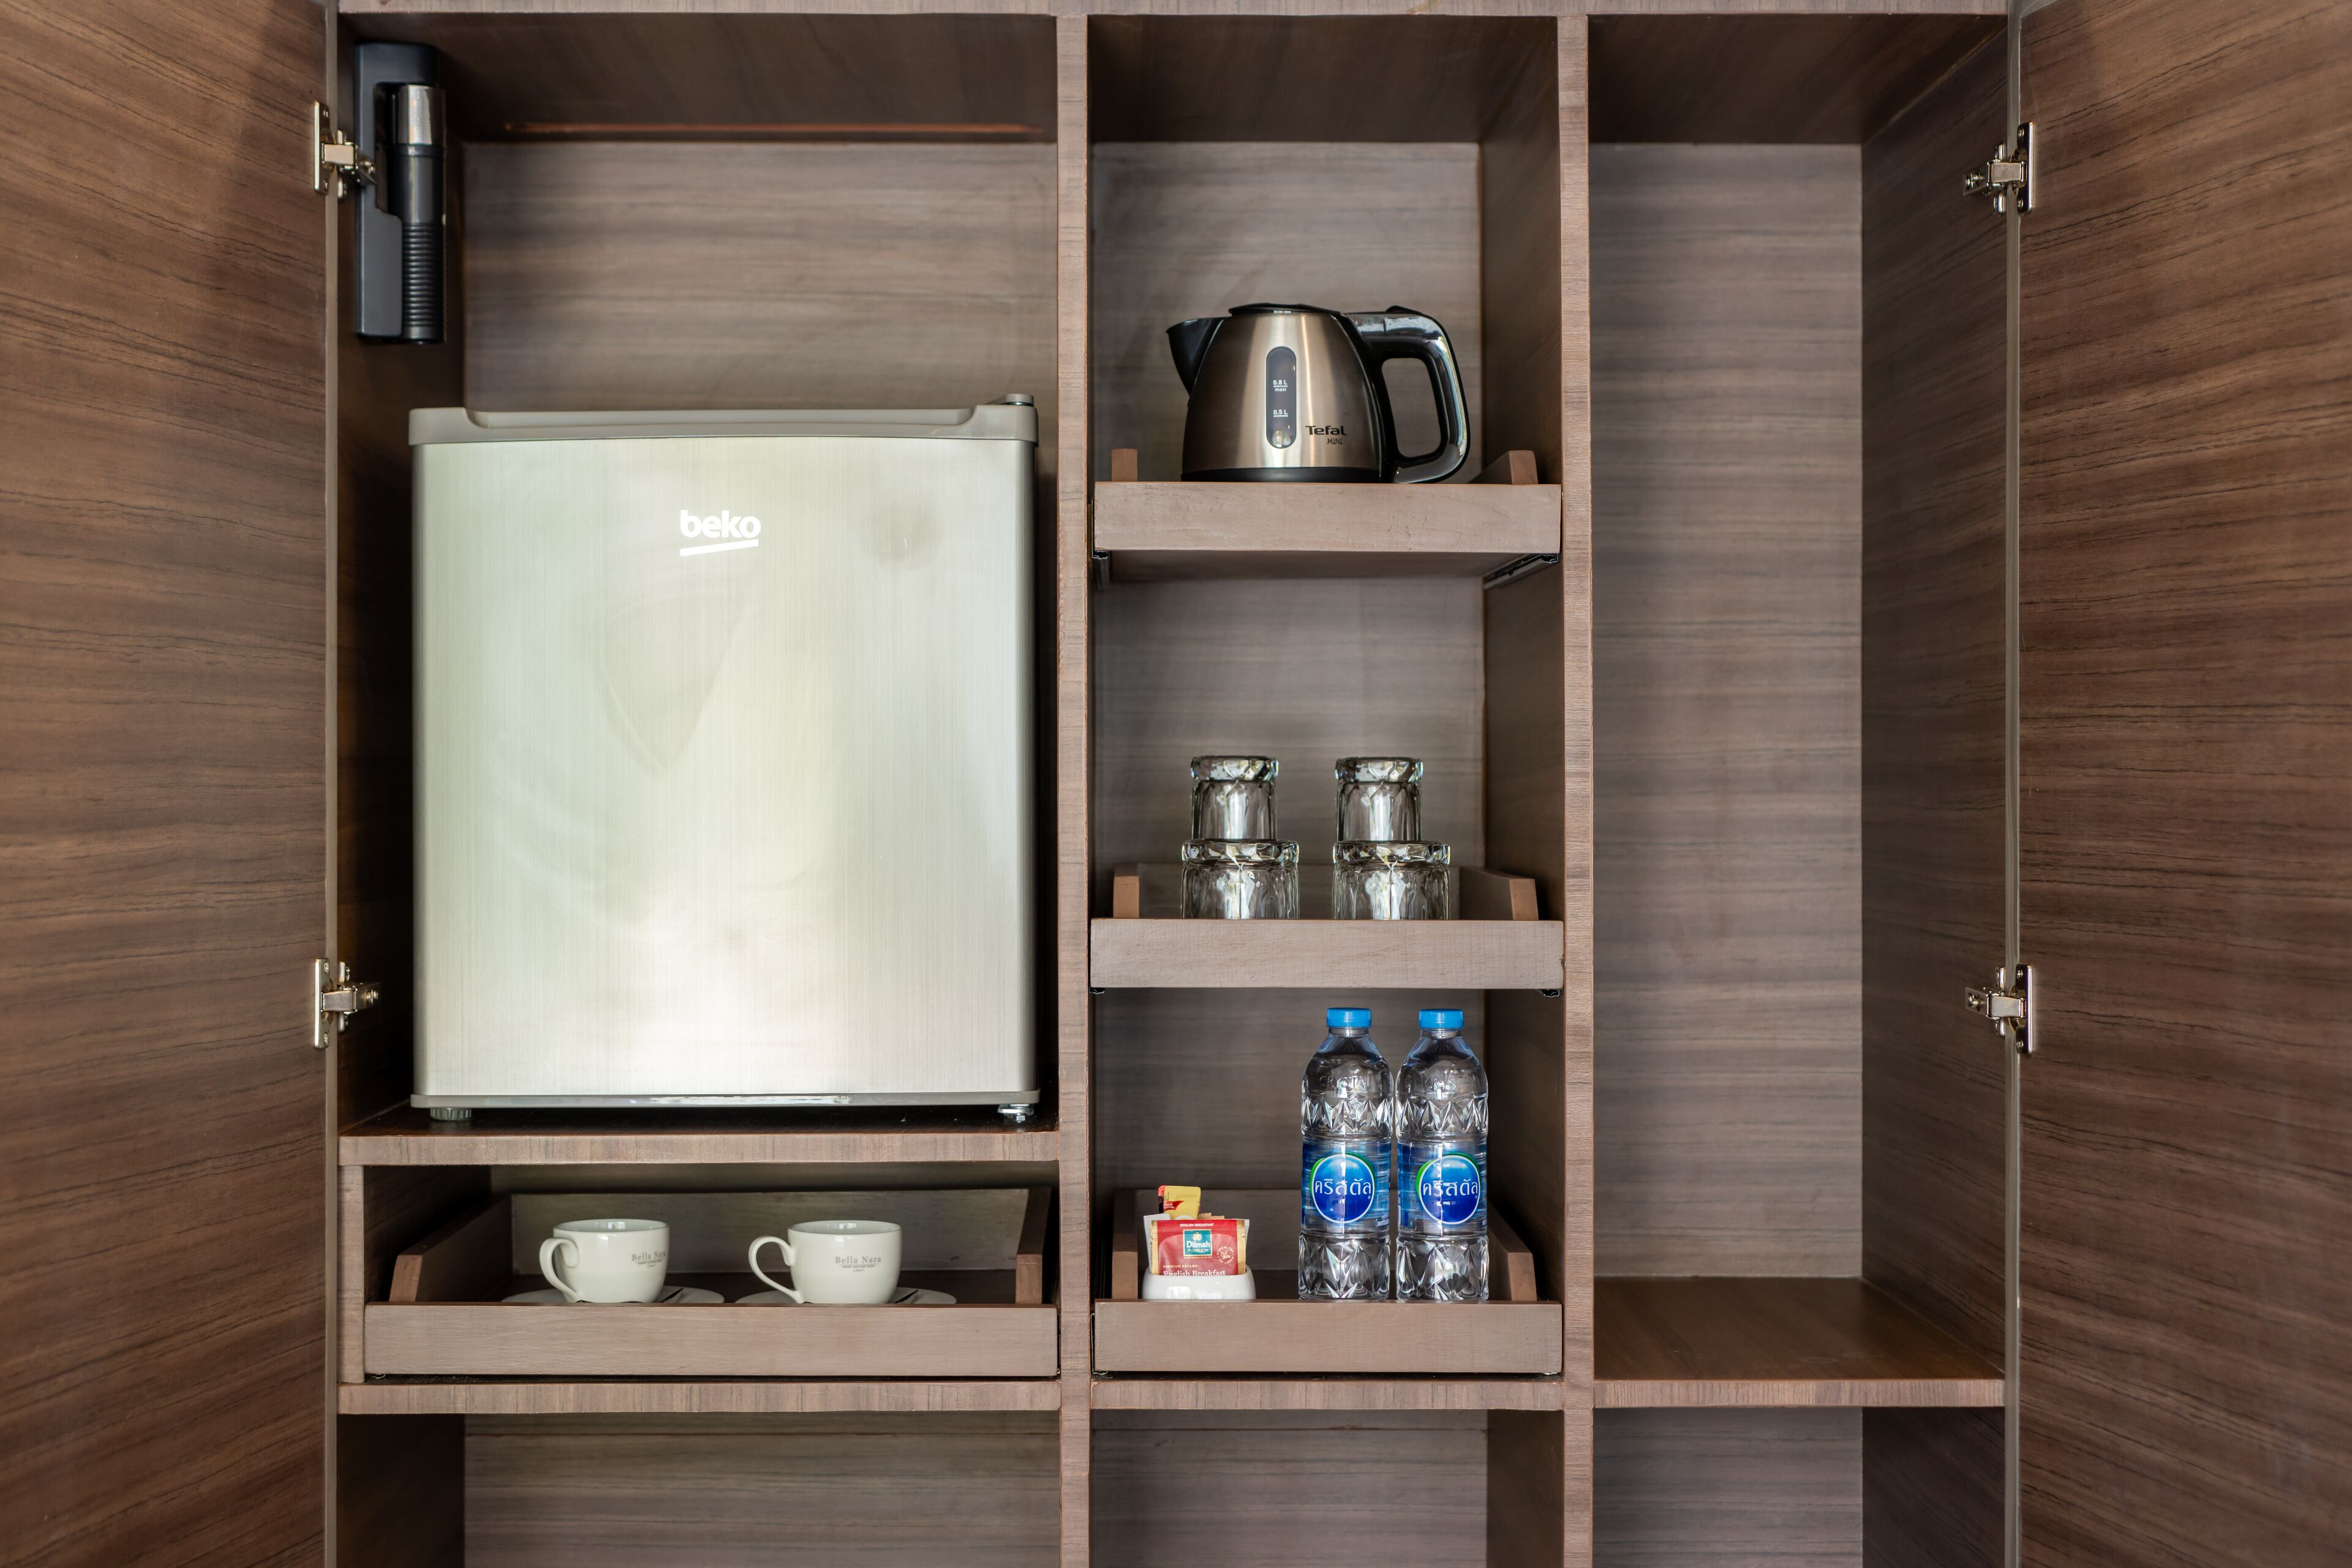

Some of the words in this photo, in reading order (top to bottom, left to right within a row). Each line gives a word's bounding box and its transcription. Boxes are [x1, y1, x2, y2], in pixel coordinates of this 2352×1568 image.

[1305, 426, 1347, 435] Tefal
[680, 510, 761, 538] beko
[1315, 1178, 1371, 1195] คริสตัล
[1423, 1178, 1478, 1196] คริสตัล
[631, 1253, 652, 1261] Bella
